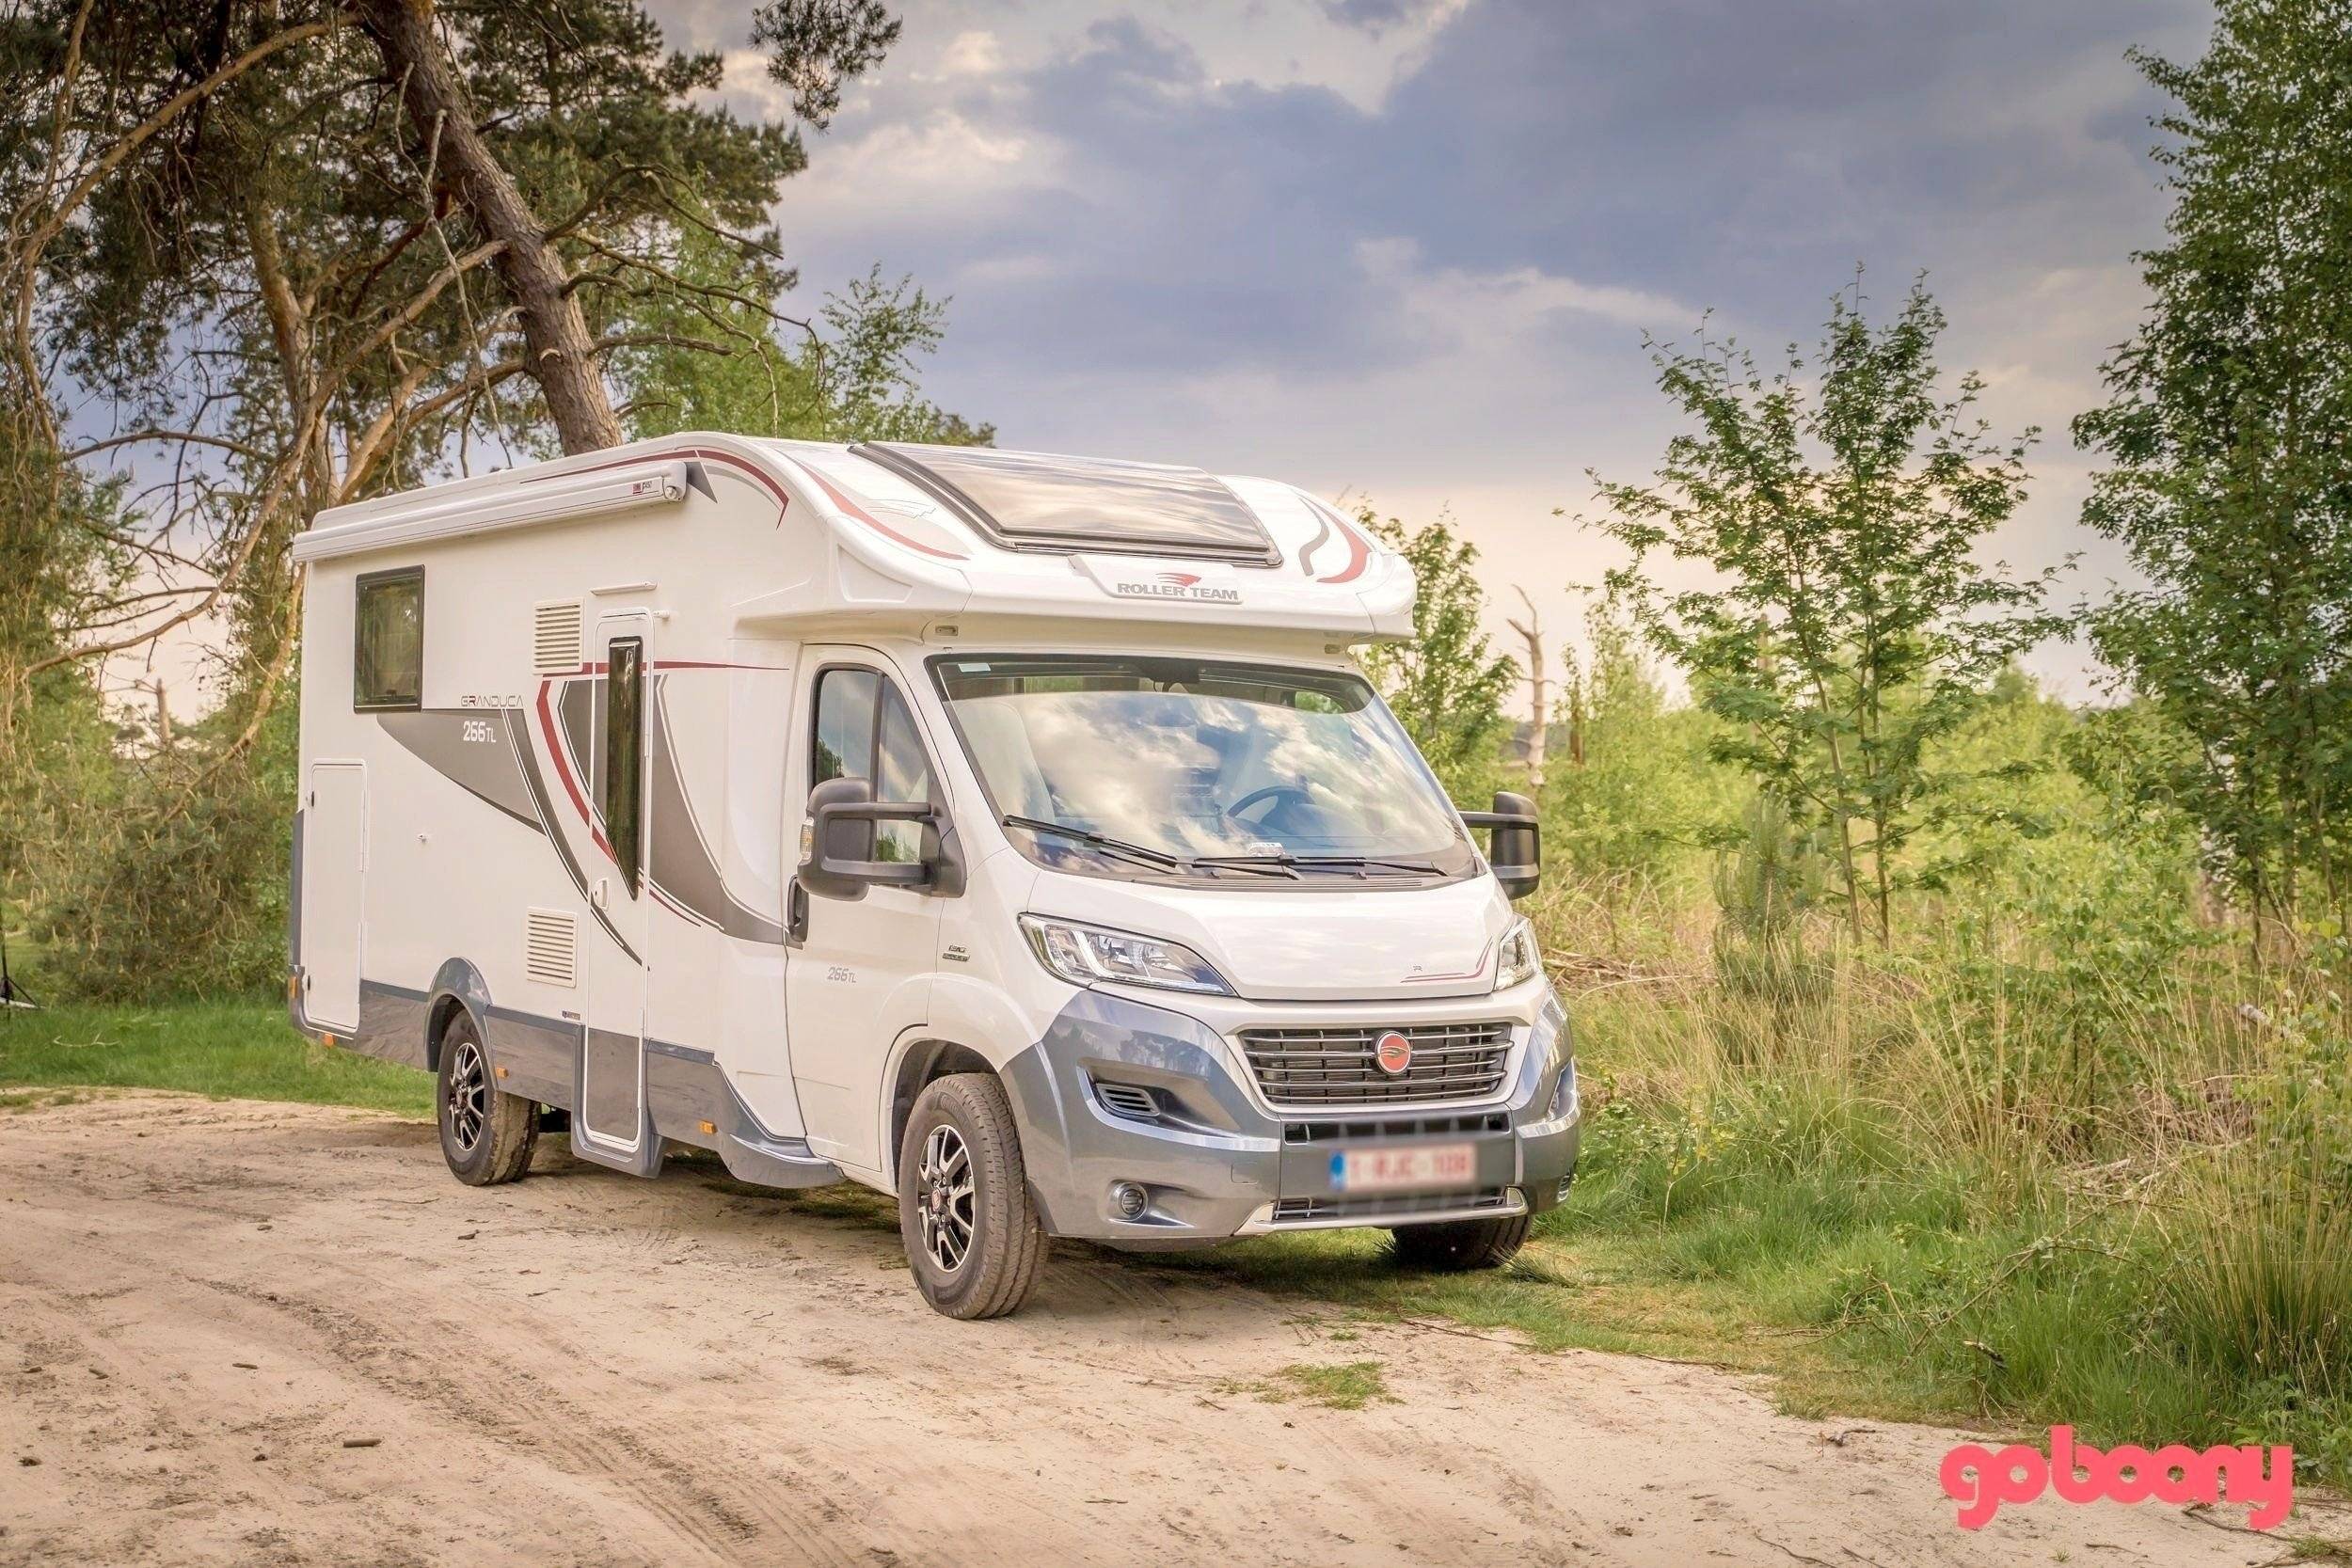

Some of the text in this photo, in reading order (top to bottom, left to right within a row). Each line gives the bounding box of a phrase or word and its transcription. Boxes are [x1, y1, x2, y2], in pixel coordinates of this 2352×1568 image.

[1117, 582, 1240, 600] ROLLER TEAM
[461, 695, 524, 707] GRANDUCA
